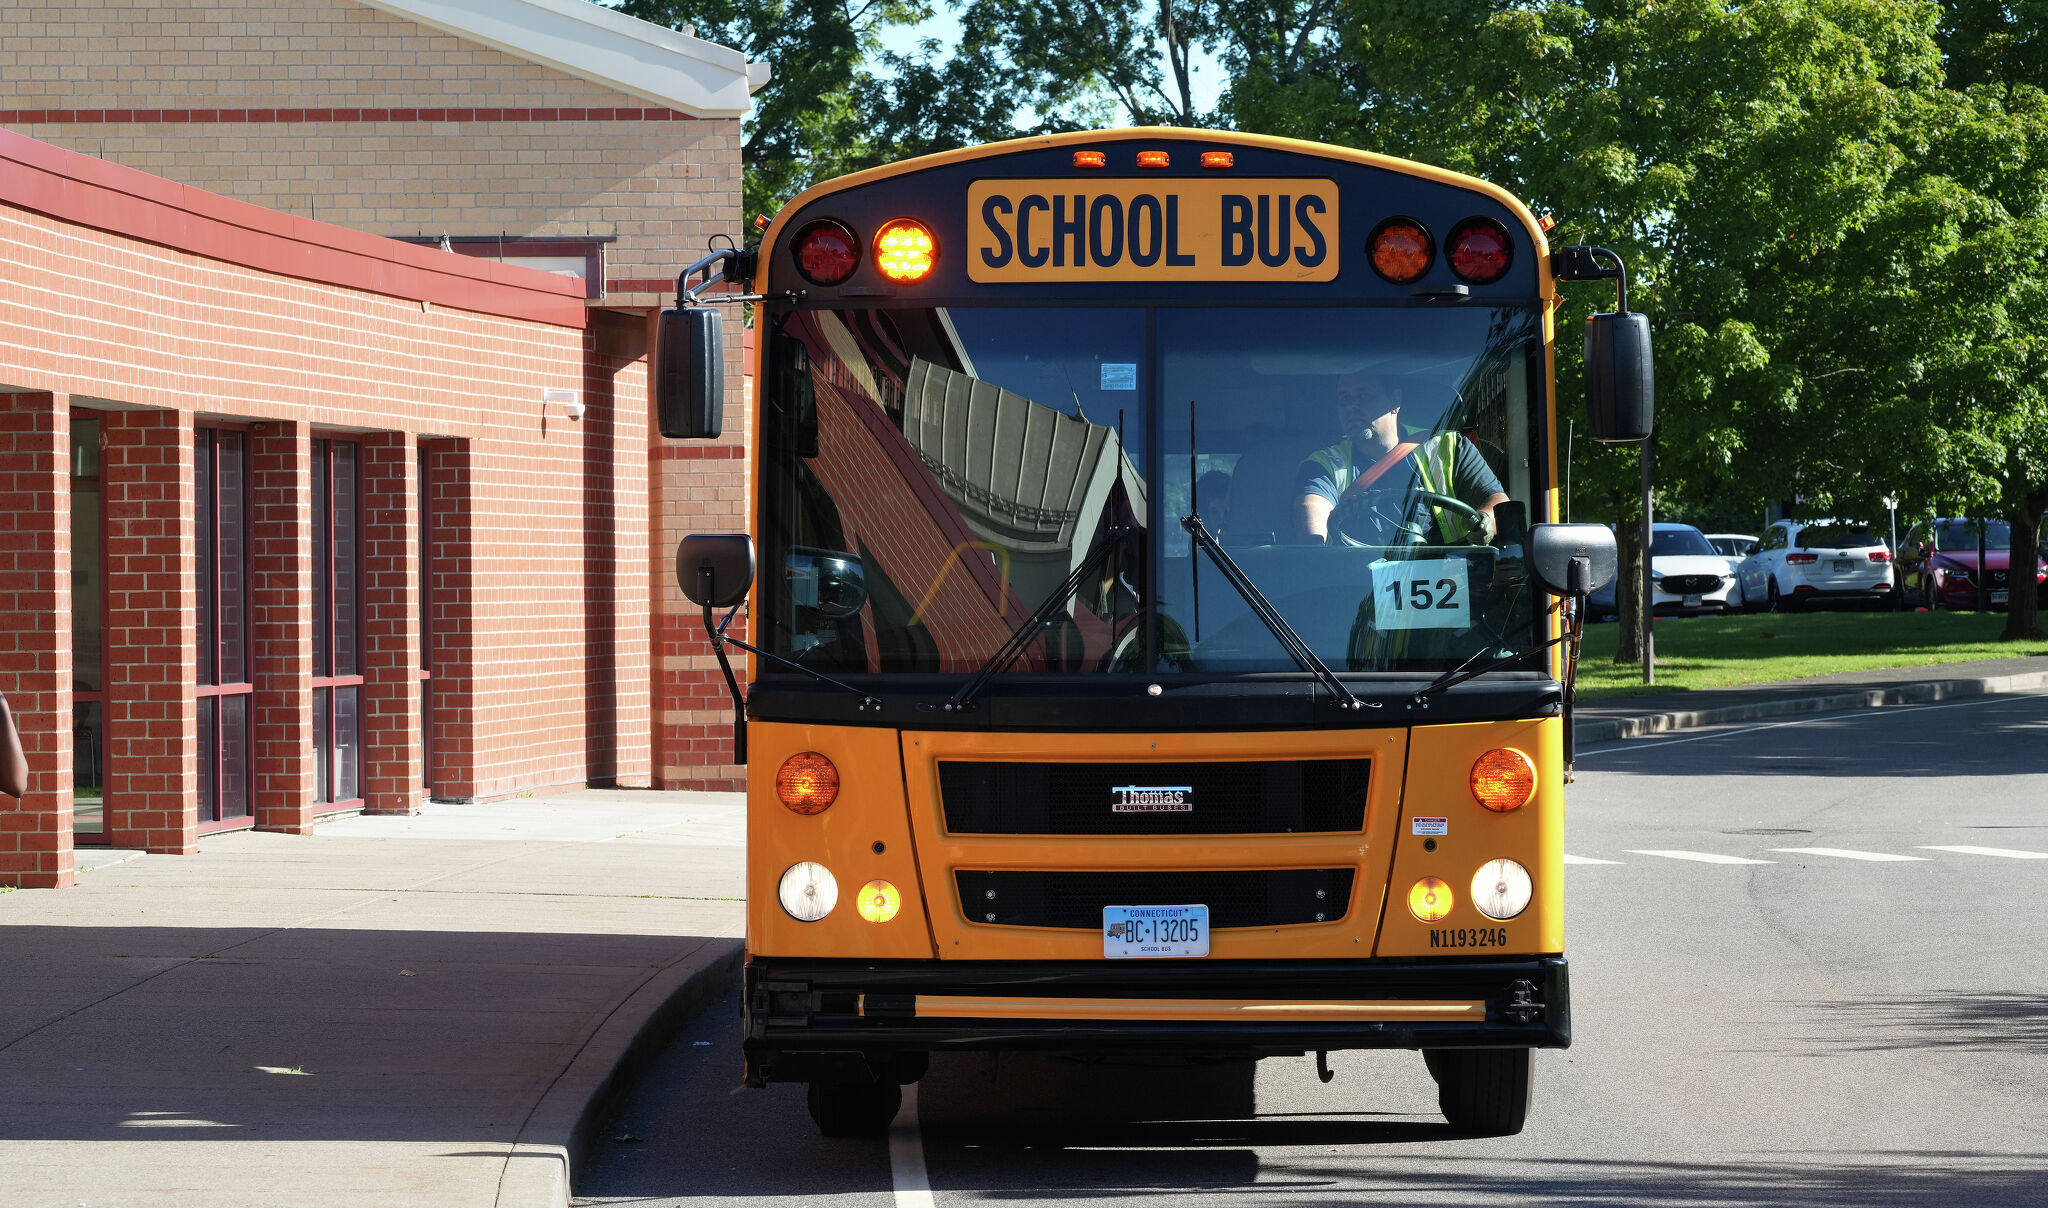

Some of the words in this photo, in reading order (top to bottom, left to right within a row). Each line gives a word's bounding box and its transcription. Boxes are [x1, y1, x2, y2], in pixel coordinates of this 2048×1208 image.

[980, 194, 1196, 268] SCHOOL
[1221, 194, 1327, 268] BUS
[1385, 578, 1459, 610] 152
[1112, 785, 1192, 804] Thomas
[1130, 909, 1183, 918] CONNECTICUT
[1430, 928, 1507, 948] N1193246
